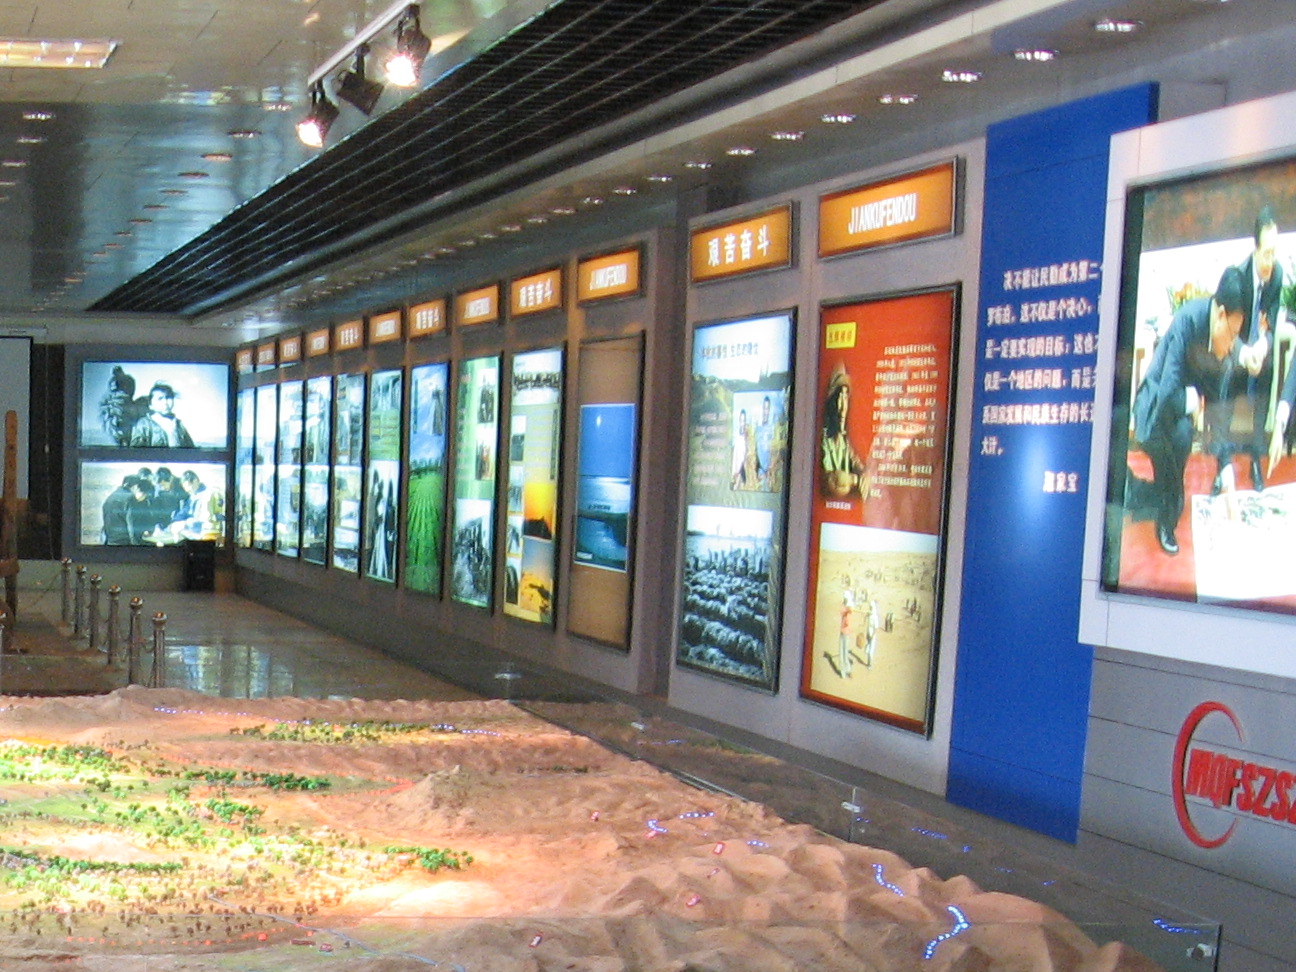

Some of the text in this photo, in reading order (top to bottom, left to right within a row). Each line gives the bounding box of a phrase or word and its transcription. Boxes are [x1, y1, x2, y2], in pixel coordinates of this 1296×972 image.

[848, 193, 918, 234] JIANKUFENDOU
[708, 225, 770, 266] 艰苦奋斗
[1003, 261, 1104, 290] 决不能让民勤成为第二
[1186, 749, 1296, 825] MQFSZS
